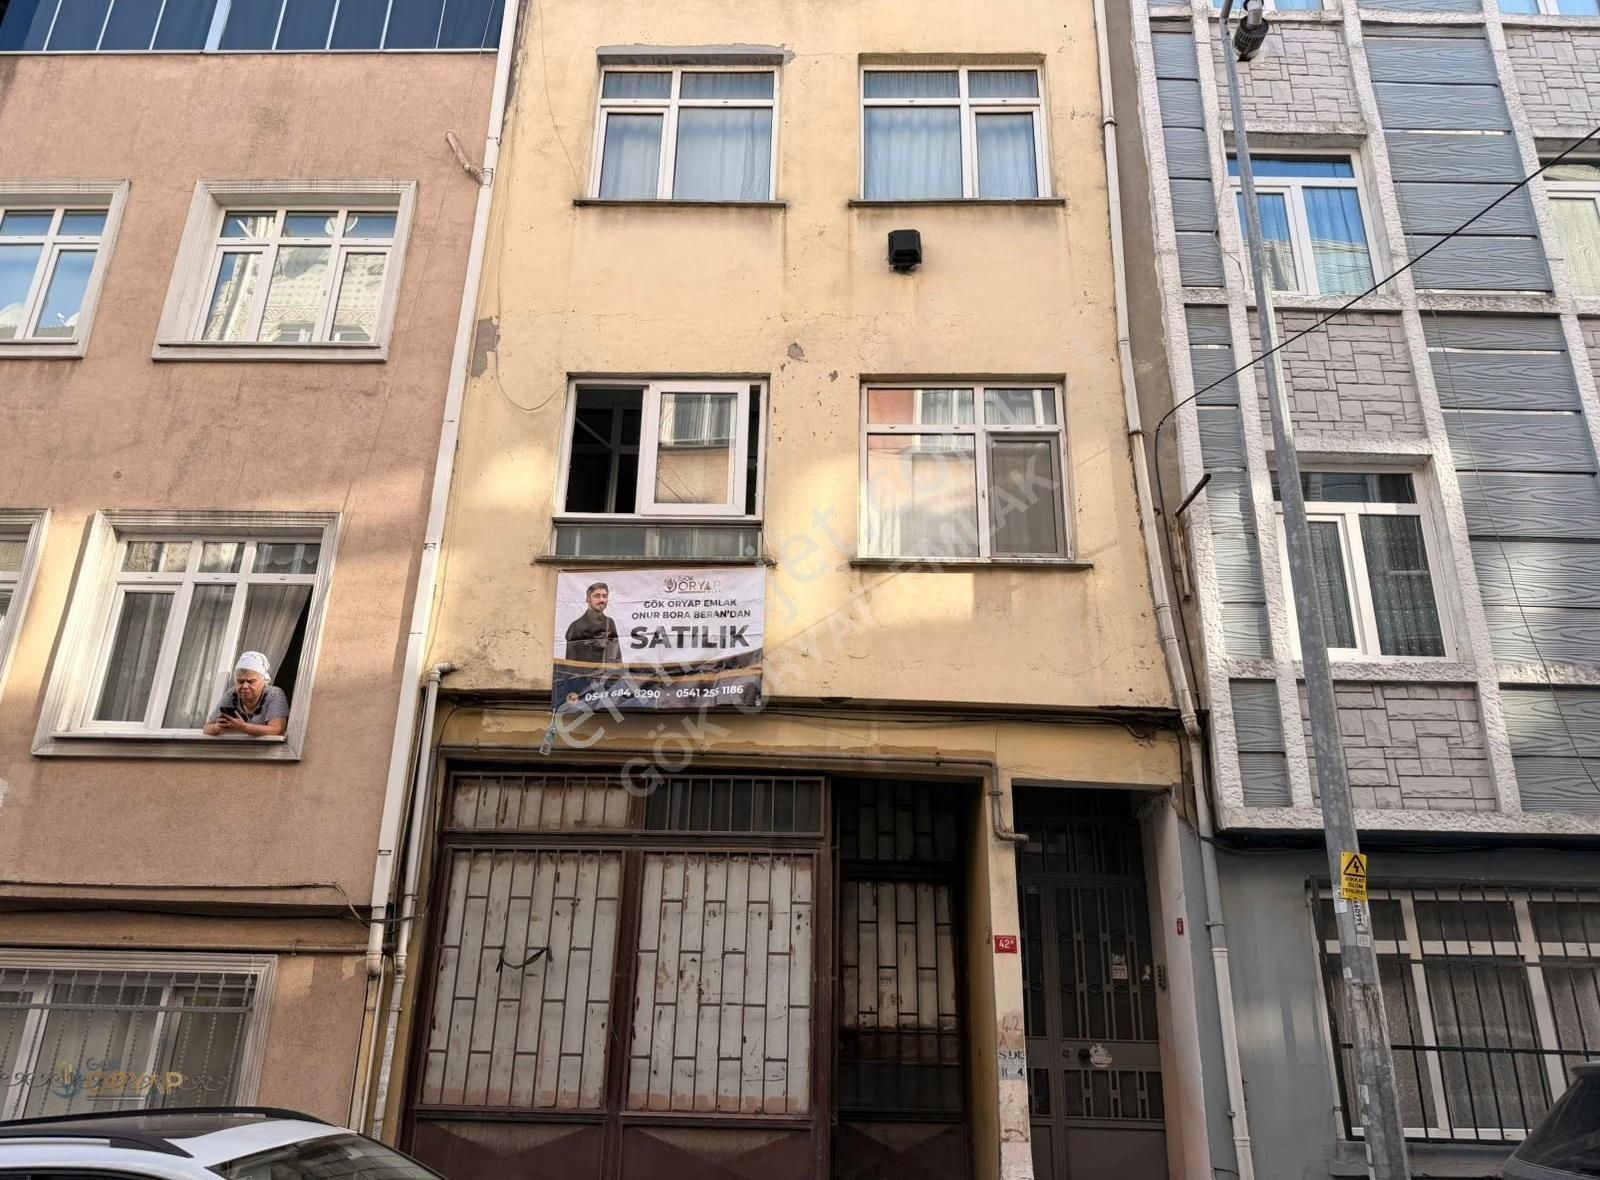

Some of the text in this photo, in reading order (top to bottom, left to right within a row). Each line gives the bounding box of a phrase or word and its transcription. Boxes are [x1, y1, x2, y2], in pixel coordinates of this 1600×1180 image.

[644, 598, 737, 608] GÖK ORYAP EMLAK
[631, 611, 660, 620] ONUR
[662, 611, 691, 619] BORA
[630, 624, 749, 649] SATILIK
[633, 689, 661, 698] 8290
[676, 688, 701, 698] 0541
[722, 685, 744, 694] 1186
